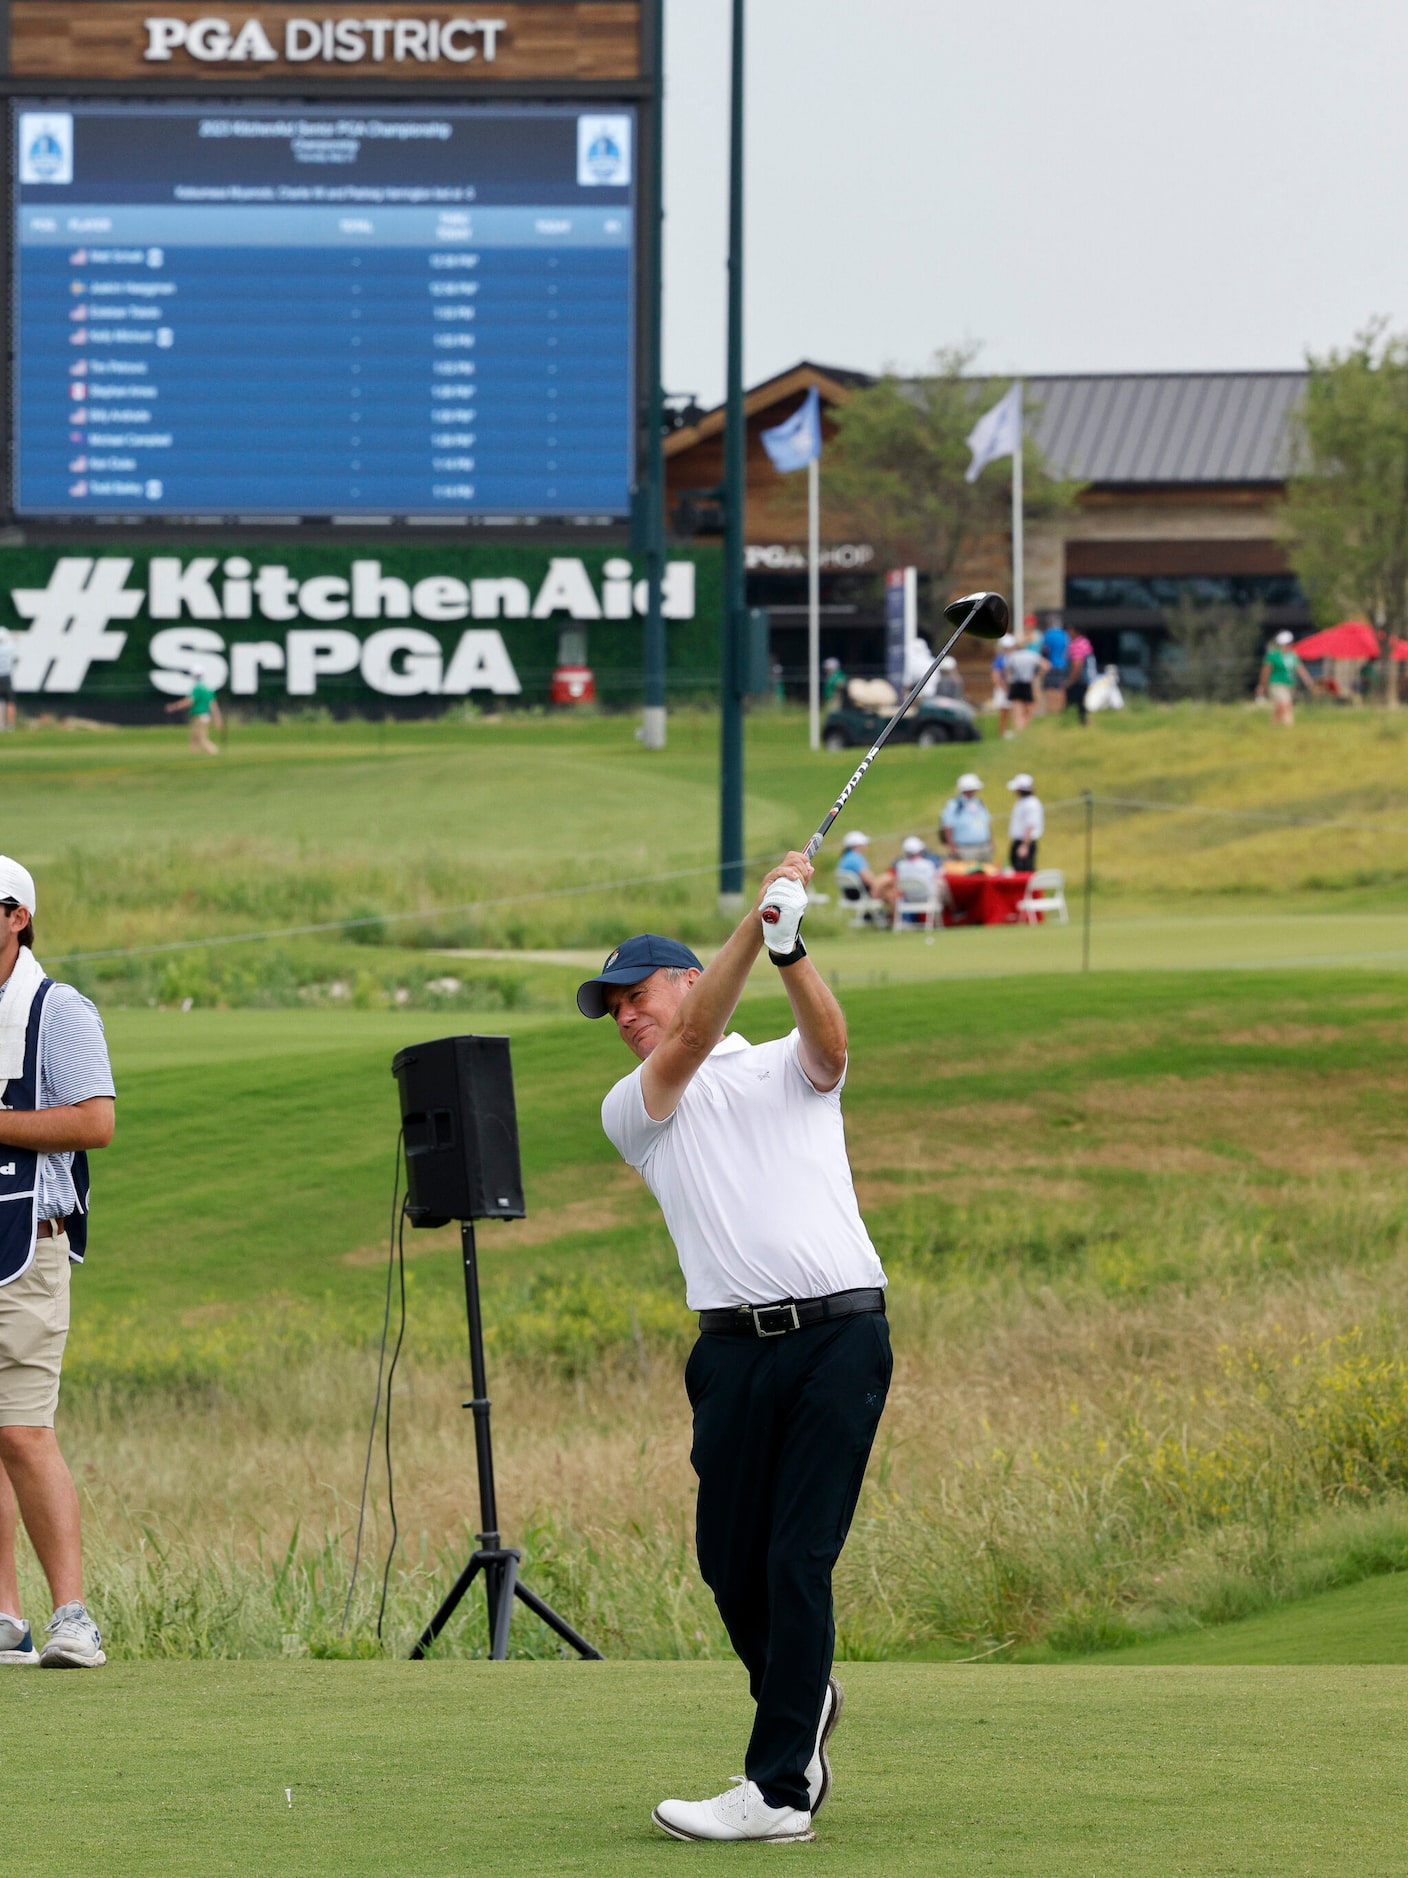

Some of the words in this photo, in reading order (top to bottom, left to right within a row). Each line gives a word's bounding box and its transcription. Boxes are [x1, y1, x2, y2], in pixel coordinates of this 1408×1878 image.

[143, 17, 279, 62] PGA
[284, 19, 506, 63] DISTRICT
[148, 626, 522, 696] SrPGA
